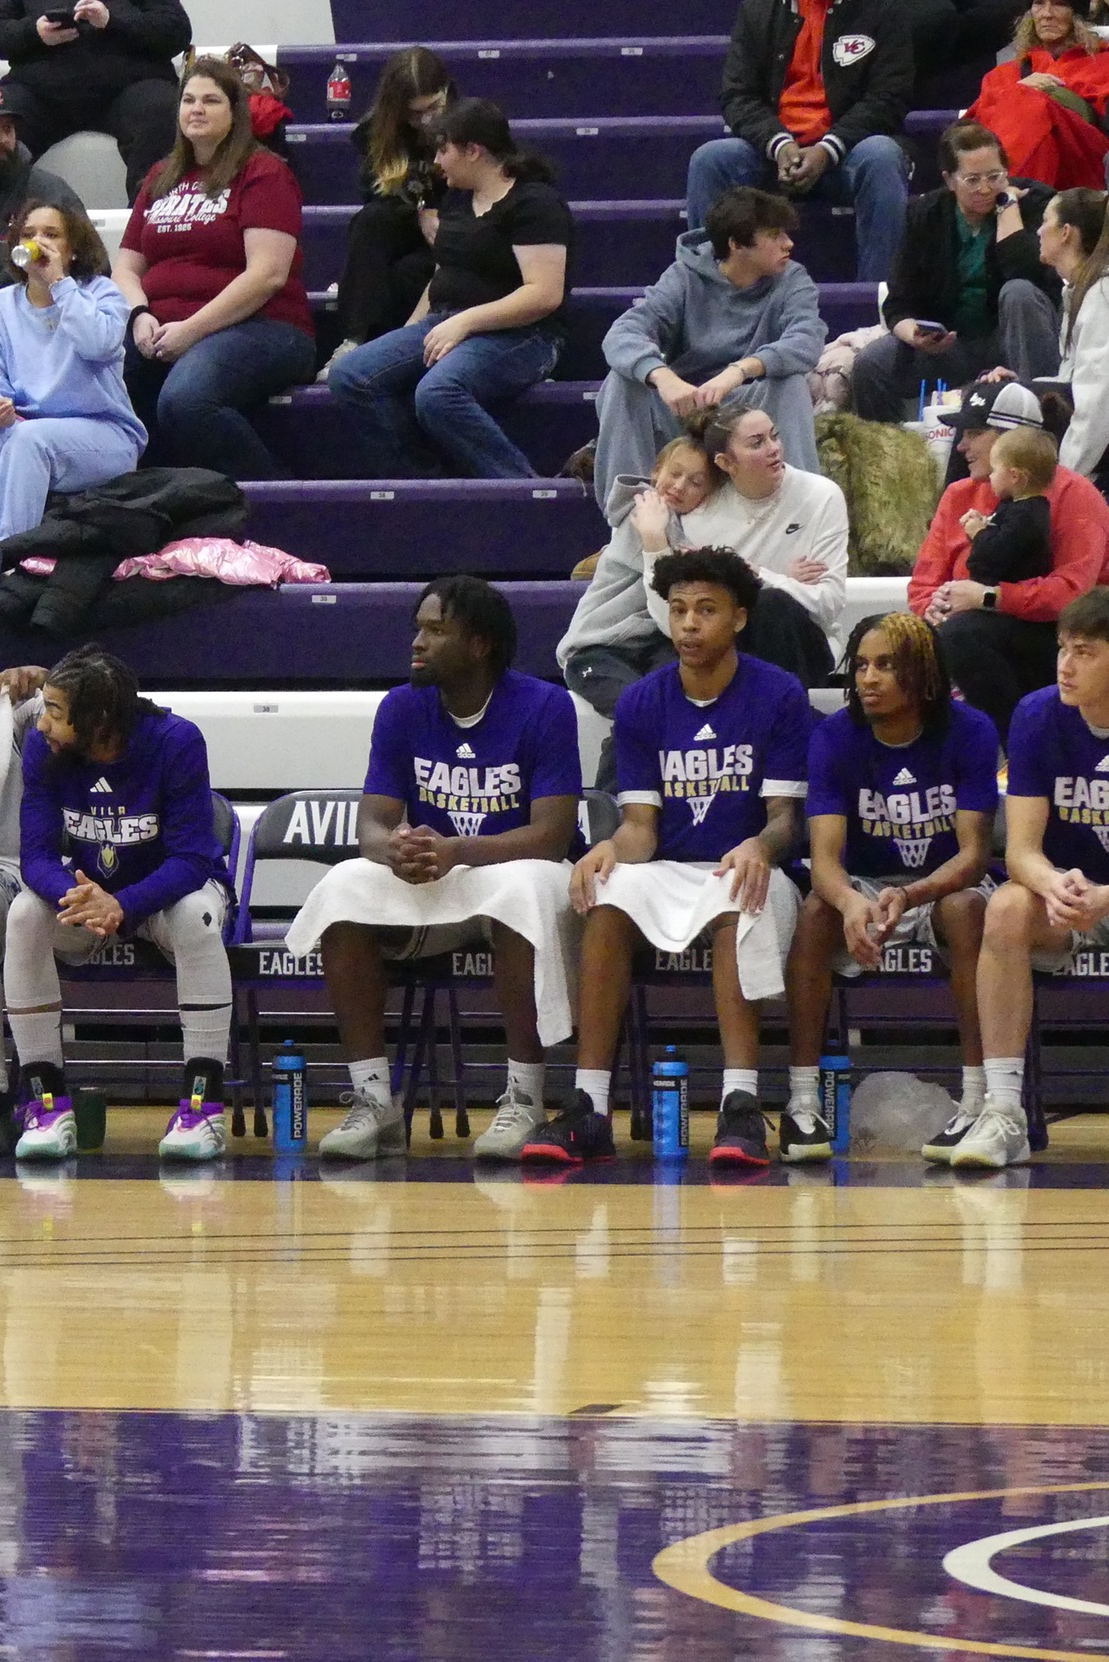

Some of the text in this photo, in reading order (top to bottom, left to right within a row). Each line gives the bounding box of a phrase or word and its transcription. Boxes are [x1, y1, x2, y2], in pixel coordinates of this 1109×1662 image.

[844, 40, 866, 55] KC
[925, 426, 955, 441] ONIC
[414, 757, 522, 798] EAGLES
[659, 744, 753, 782] AGLES
[664, 775, 750, 798] ASKETALL
[858, 784, 957, 825] EAGLES
[63, 808, 159, 845] EAGLES
[90, 805, 126, 816] VILA
[293, 1072, 303, 1139] POWERADE
[680, 1079, 688, 1146] POWERADE
